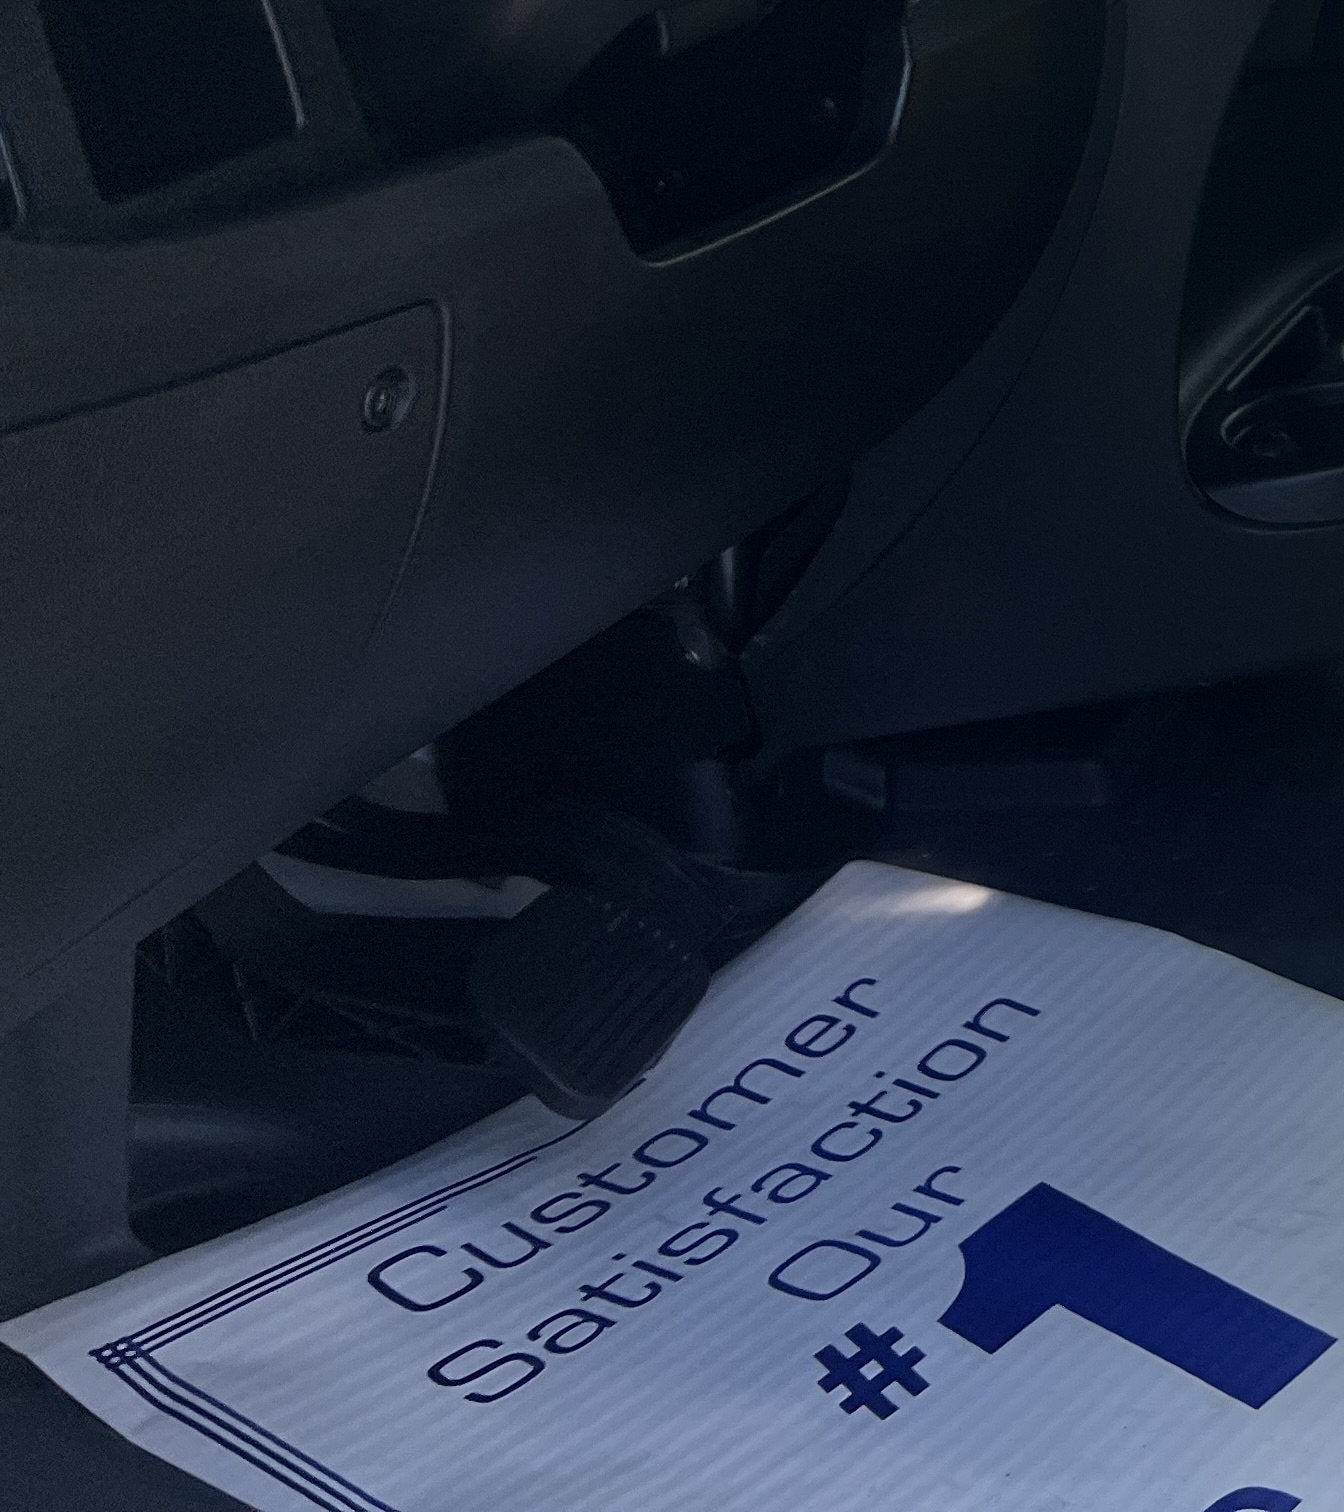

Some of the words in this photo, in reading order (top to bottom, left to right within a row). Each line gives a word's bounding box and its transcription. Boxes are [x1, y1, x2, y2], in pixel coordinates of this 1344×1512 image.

[365, 975, 885, 1314] Customer
[425, 996, 1043, 1406] Satisfaction
[767, 1163, 966, 1303] Our
[813, 1180, 1339, 1422] #1
